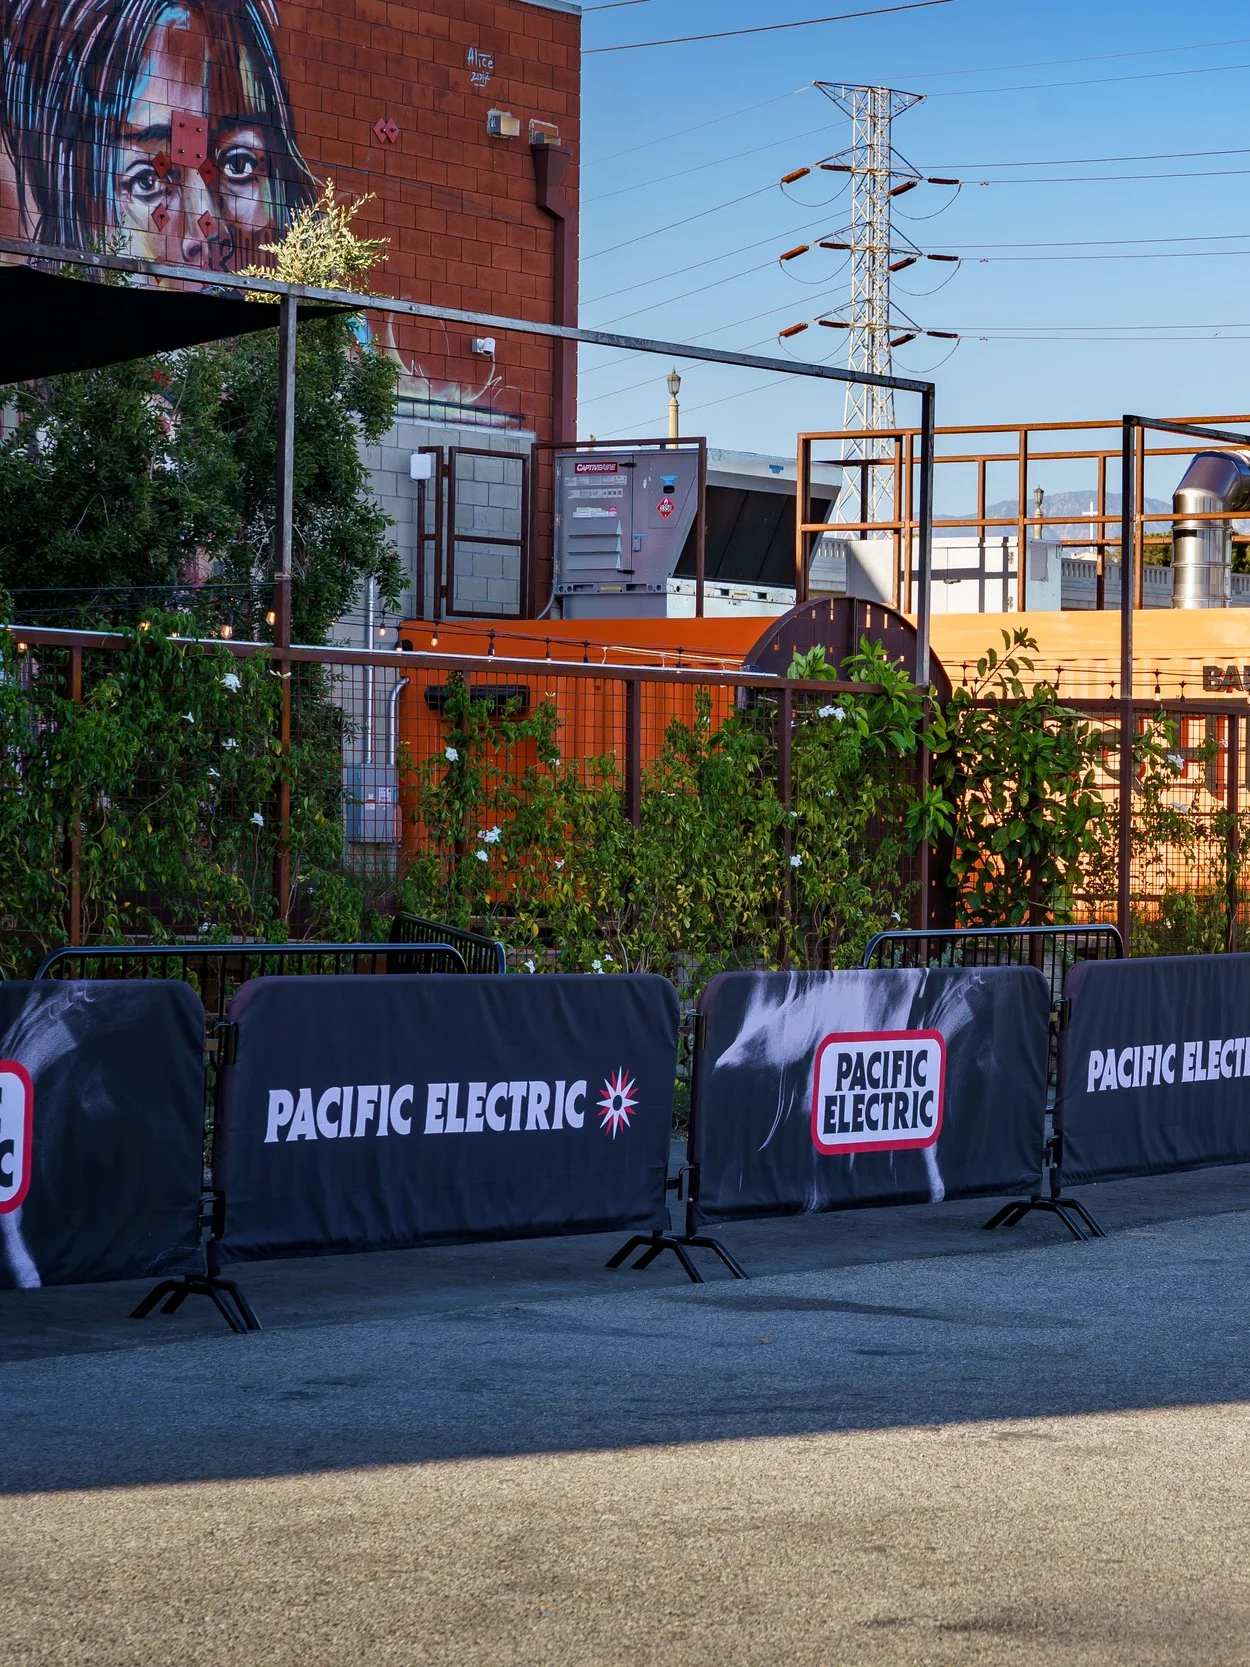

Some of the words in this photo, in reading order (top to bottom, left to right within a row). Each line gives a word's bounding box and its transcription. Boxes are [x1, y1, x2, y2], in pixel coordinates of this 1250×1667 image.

[835, 1049, 928, 1091] PACIFIC
[1086, 1043, 1177, 1093] PACIFIC
[263, 1083, 415, 1143] PACIFIC
[423, 1079, 588, 1135] ELECTRIC
[822, 1090, 934, 1134] ELECTRIC
